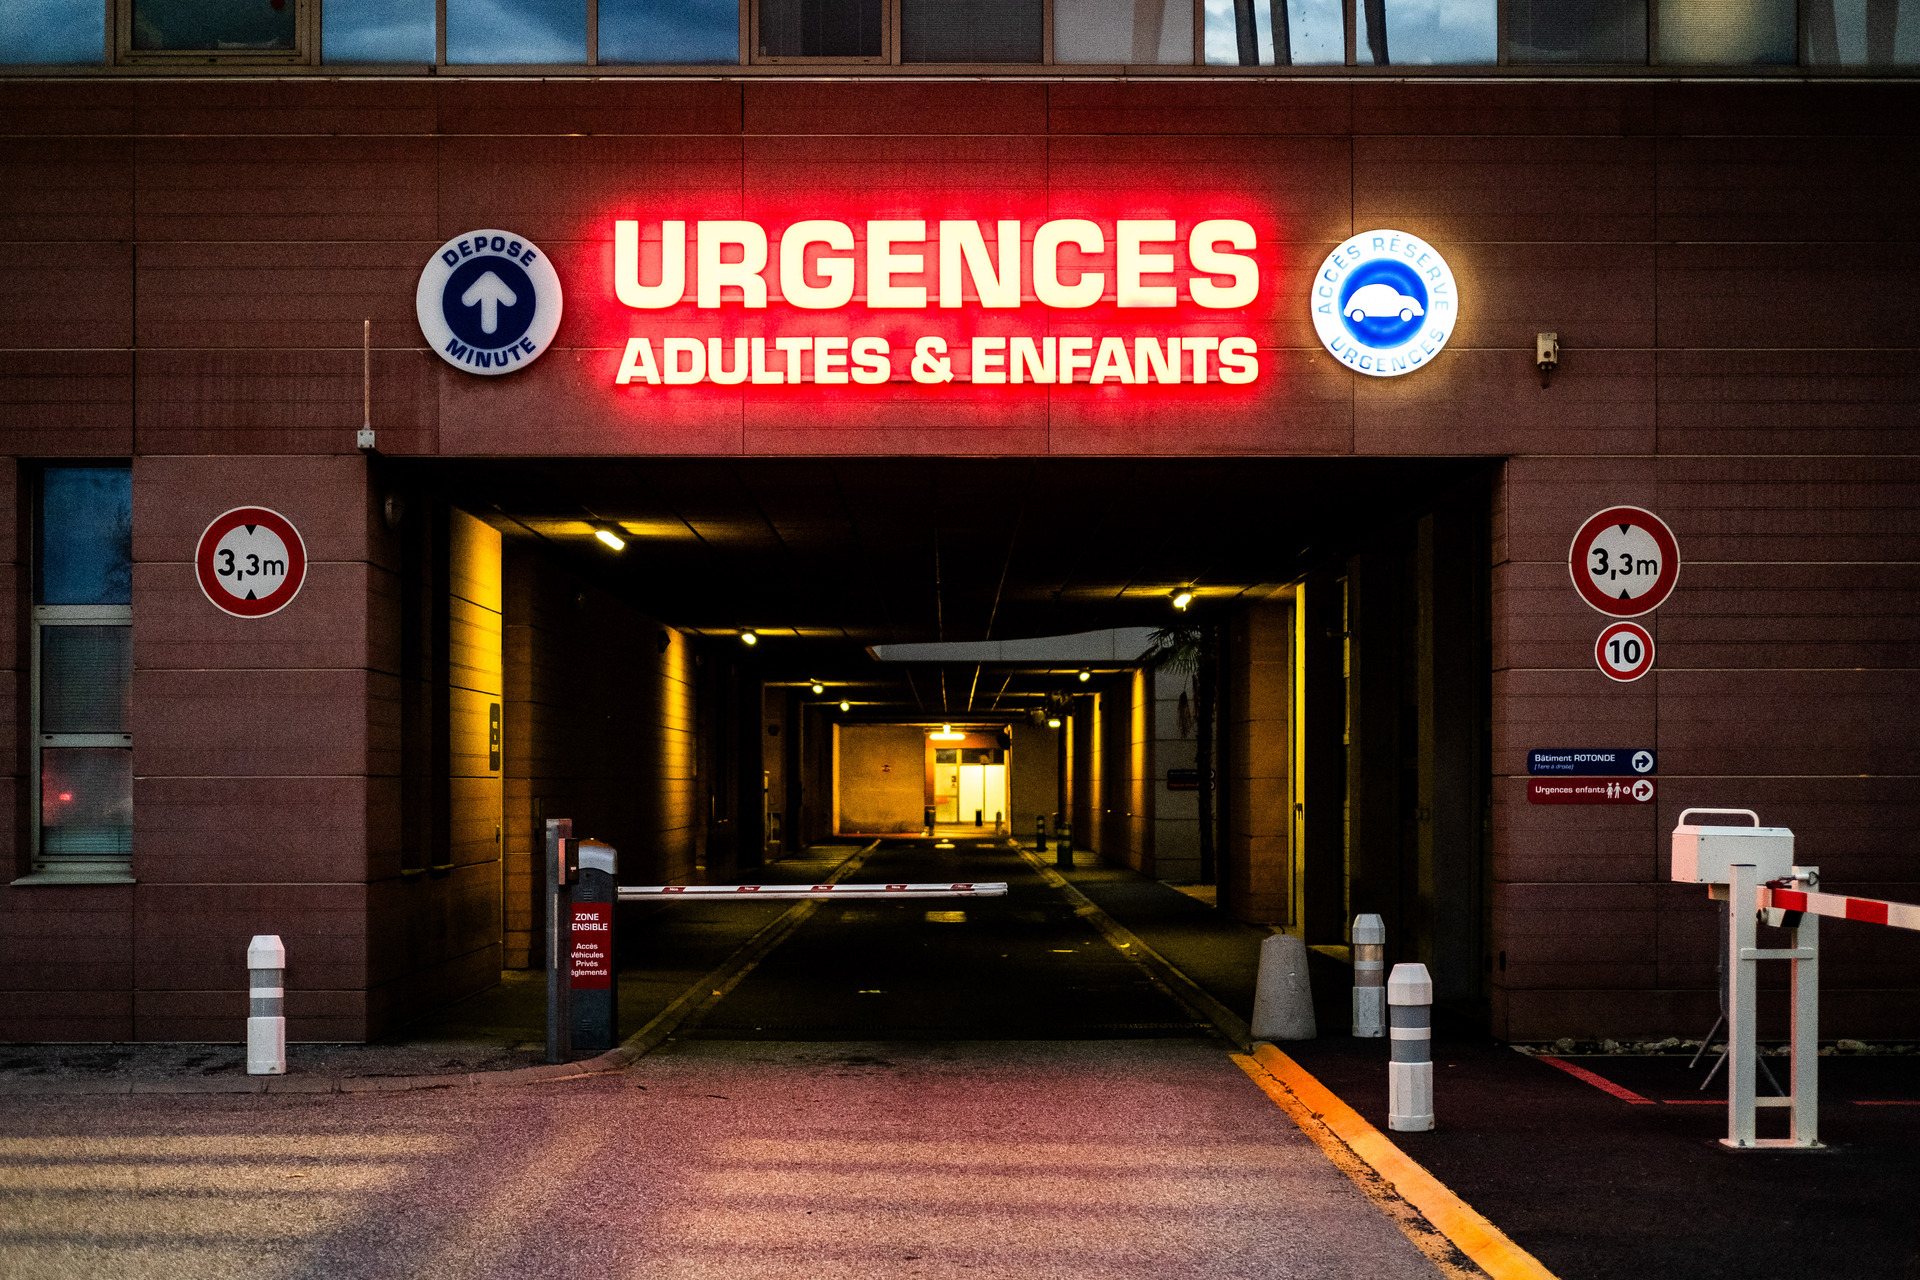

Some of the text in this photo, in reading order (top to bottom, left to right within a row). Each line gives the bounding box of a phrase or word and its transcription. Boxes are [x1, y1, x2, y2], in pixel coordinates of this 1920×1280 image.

[442, 236, 537, 267] DEPOSE
[614, 219, 1259, 309] URGENCES
[445, 336, 537, 368] MINUTE
[1330, 328, 1444, 372] URGENCES
[615, 336, 1259, 385] ADULTES & ENFANTS
[1609, 639, 1641, 664] 10
[1534, 753, 1616, 762] Bâtiment ROTONDE
[1535, 785, 1606, 795] Urgences enfants
[575, 912, 600, 921] ZONE
[571, 922, 608, 931] ENSIBLE
[576, 942, 599, 950] Accès
[571, 951, 605, 959] Véhicules
[571, 969, 608, 978] églementé
